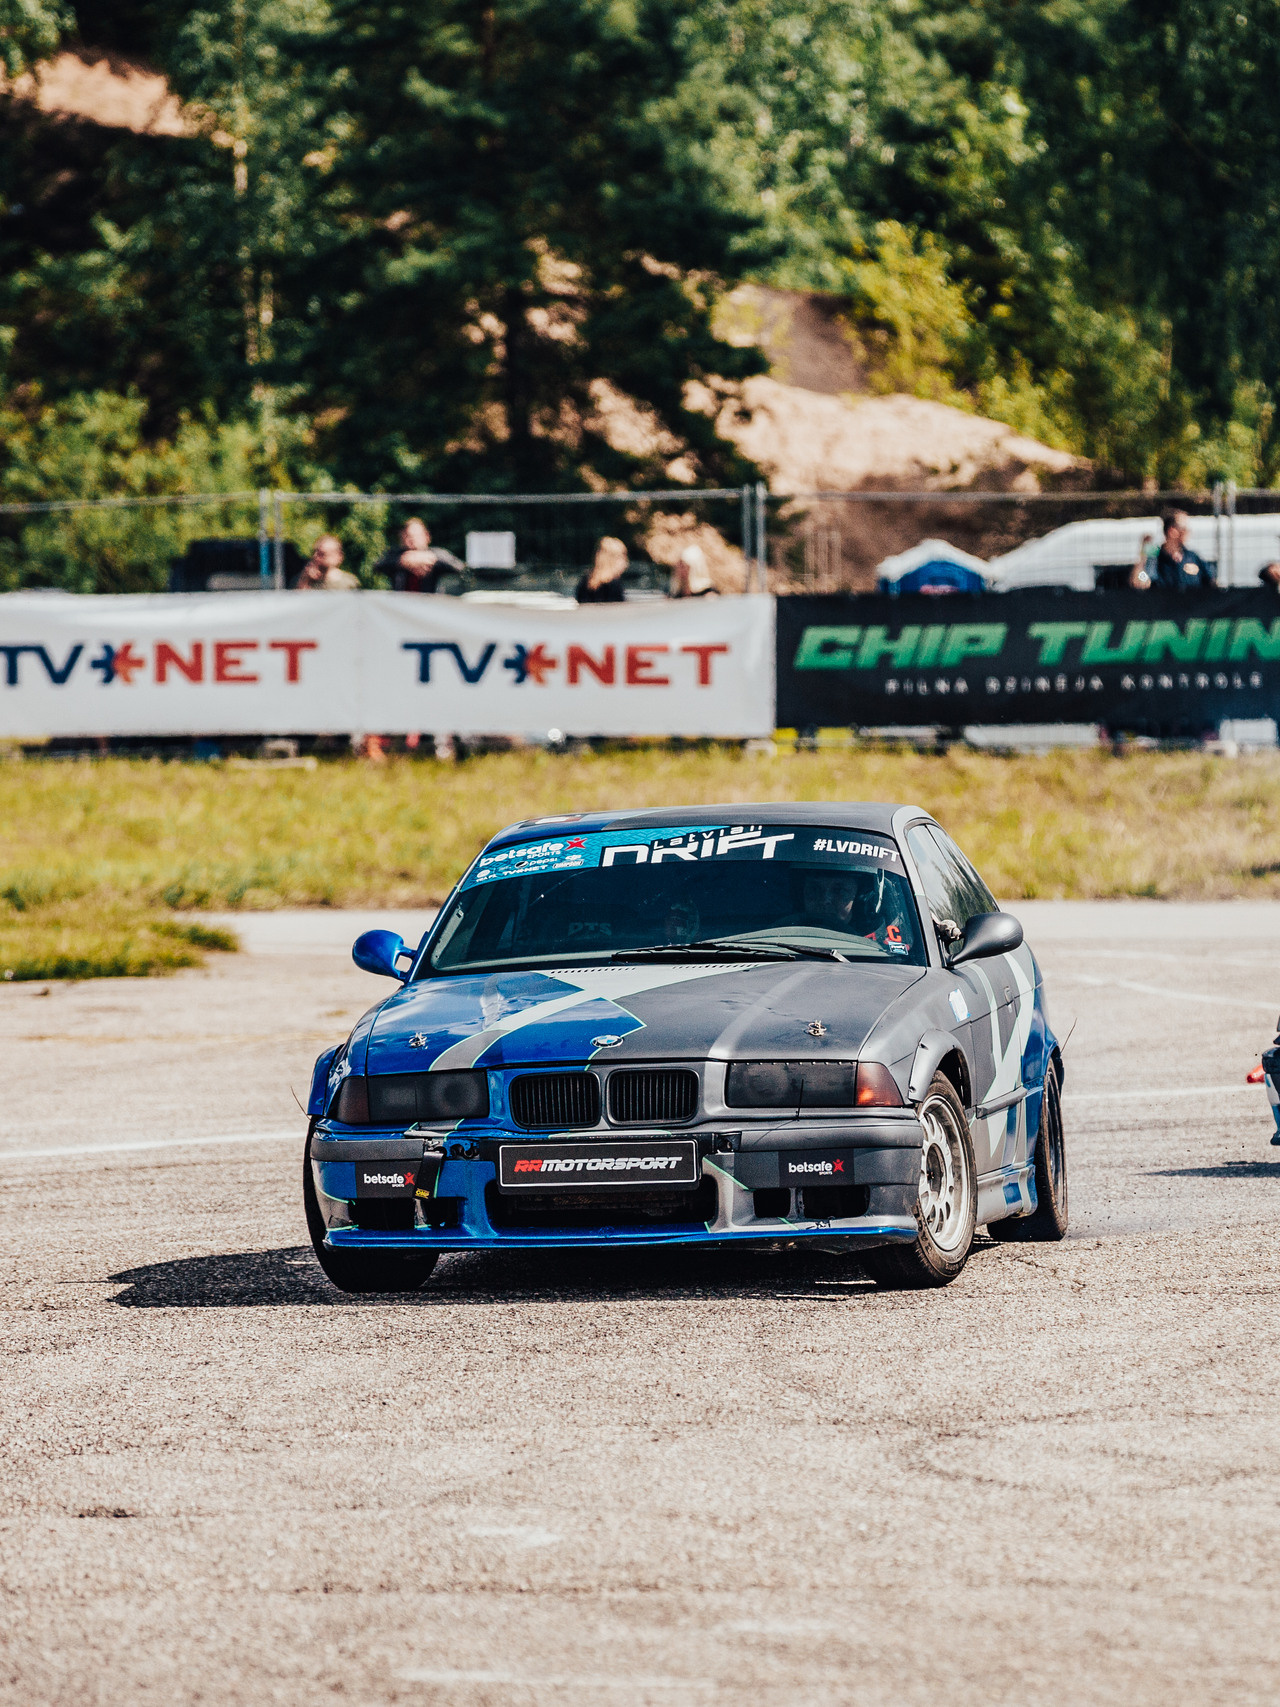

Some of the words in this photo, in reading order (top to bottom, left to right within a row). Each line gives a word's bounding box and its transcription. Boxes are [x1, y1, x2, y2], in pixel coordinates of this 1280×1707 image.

[794, 622, 1010, 670] CHIP
[479, 842, 565, 868] betsafe
[813, 838, 899, 862] #LVDRIFT
[514, 1156, 682, 1173] RRMOTORSPORT
[788, 1160, 833, 1173] betsafe
[363, 1173, 405, 1184] betsafe
